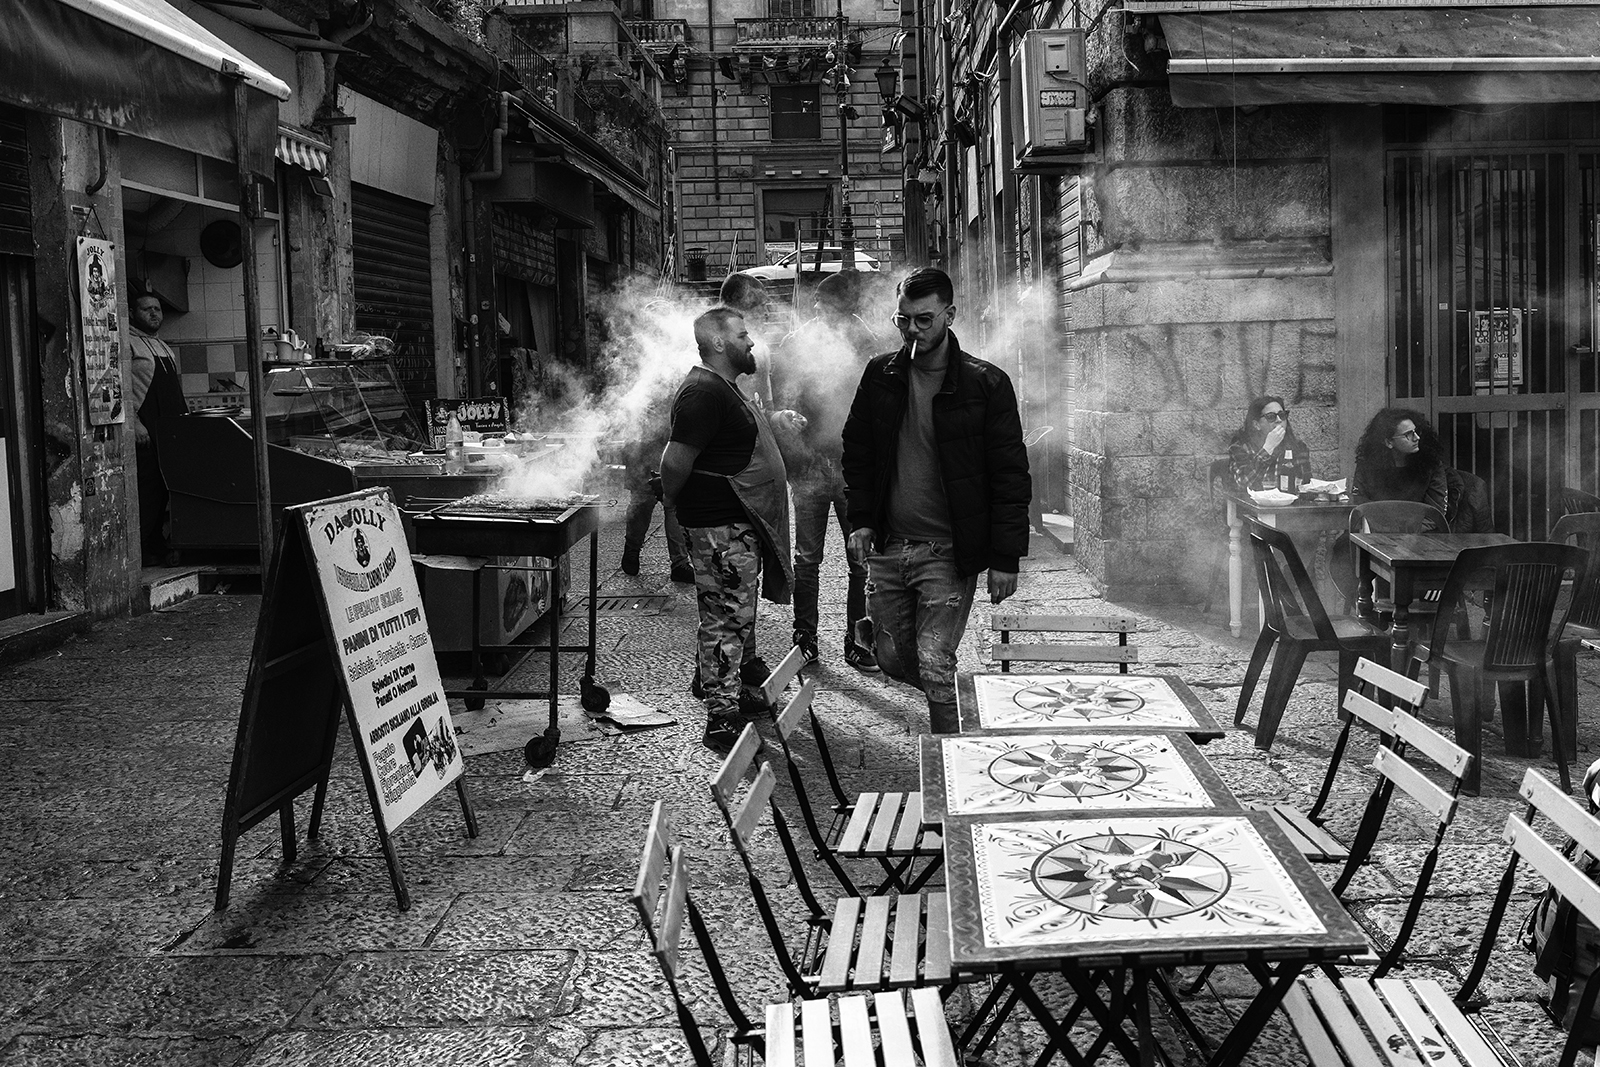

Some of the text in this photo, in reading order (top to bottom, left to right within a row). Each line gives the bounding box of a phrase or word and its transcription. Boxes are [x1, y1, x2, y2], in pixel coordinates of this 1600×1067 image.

[86, 246, 104, 256] JOLLY
[457, 400, 501, 422] JOLLY
[324, 508, 386, 545] DA JOLLY
[342, 629, 370, 656] PANINI
[368, 625, 380, 643] DI
[378, 615, 402, 639] TUTTI
[404, 607, 421, 627] TIPI
[408, 631, 427, 651] Carne
[399, 662, 415, 678] Carne
[369, 691, 439, 745] ARROSTO SICILIANO ALLA GRIGLIA
[372, 741, 396, 768] Fegato
[376, 756, 397, 779] Cuore
[380, 758, 413, 793] Fiorentina
